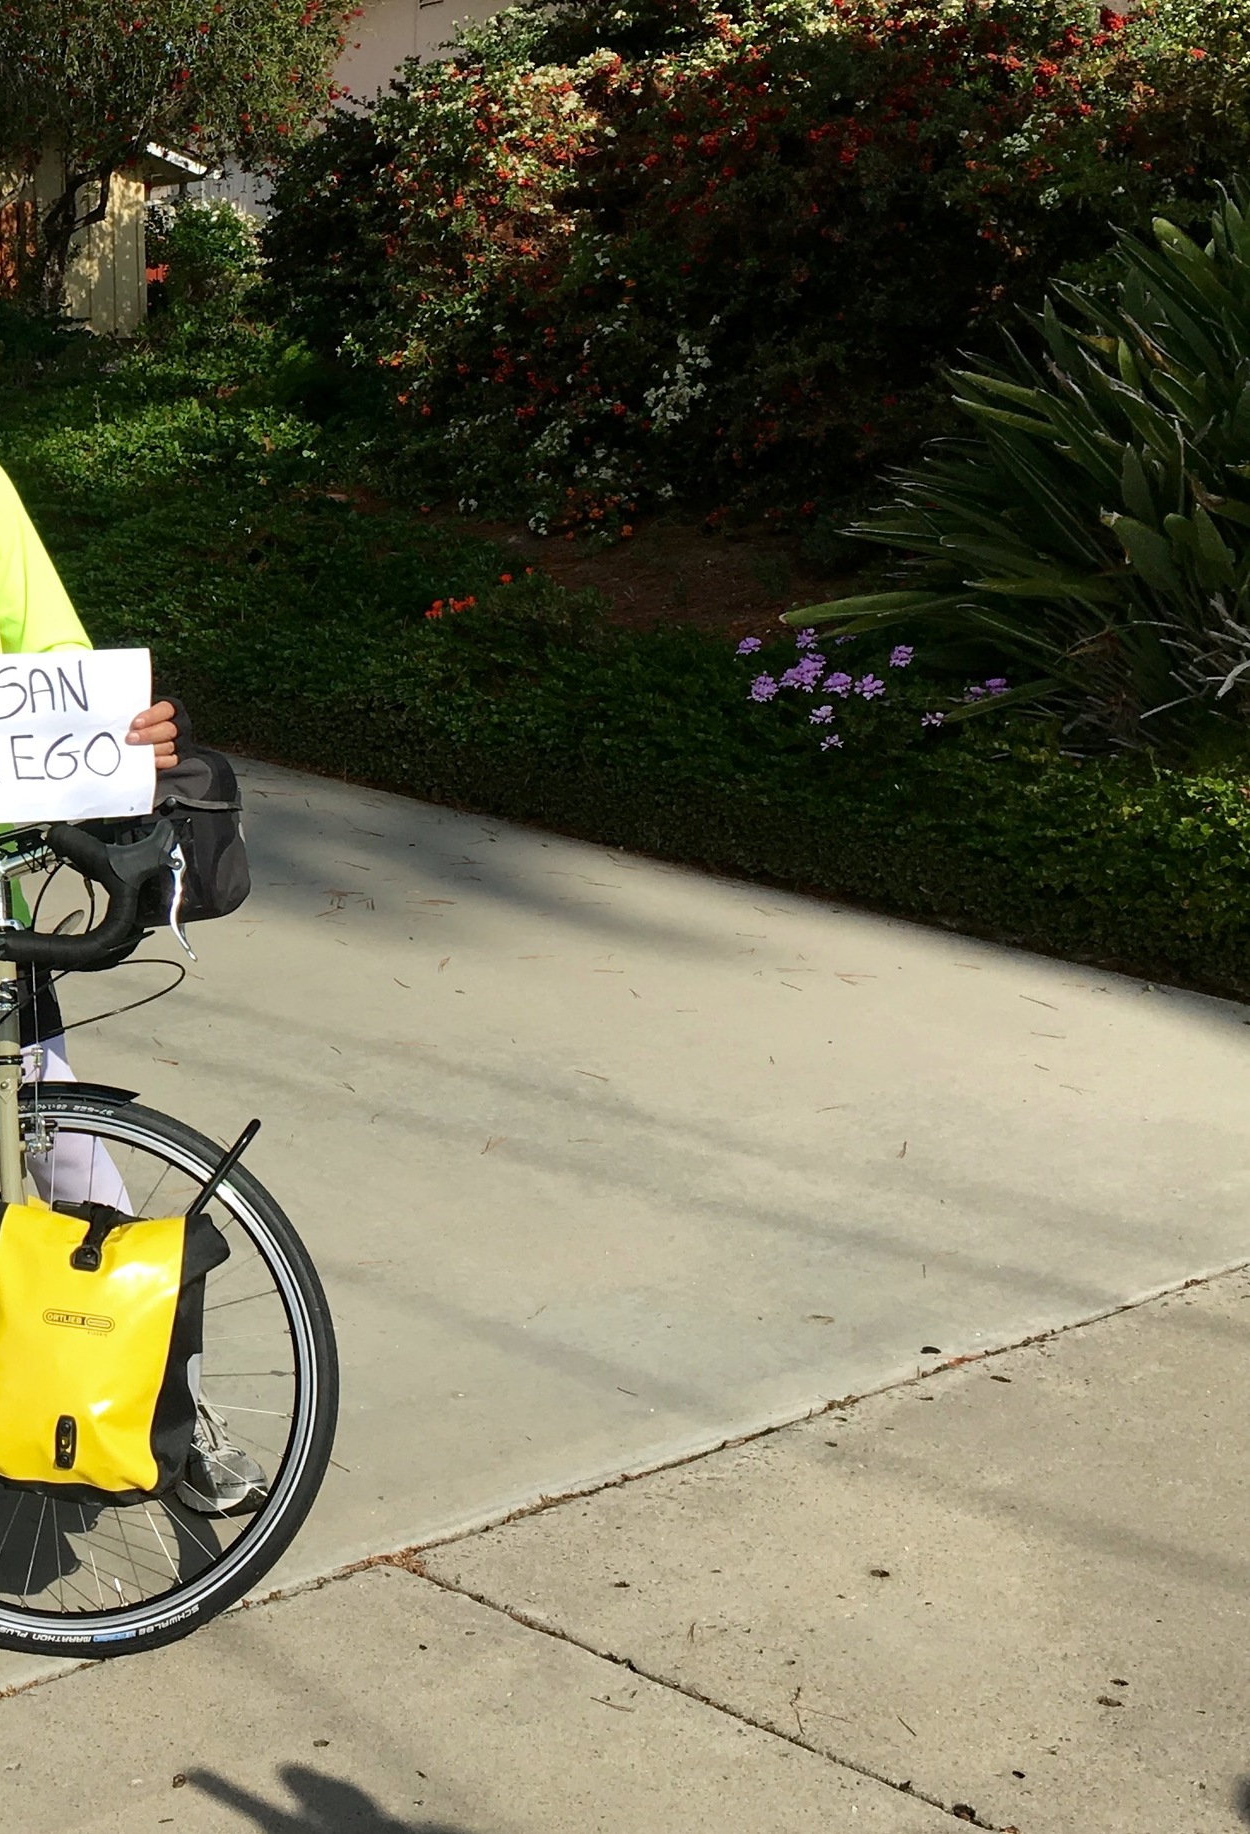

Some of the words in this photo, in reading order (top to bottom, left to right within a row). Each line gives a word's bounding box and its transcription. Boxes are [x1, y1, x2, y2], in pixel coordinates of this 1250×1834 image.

[47, 1312, 83, 1325] ORTLIEB
[138, 1603, 200, 1636] SCHWALBE
[0, 1627, 29, 1639] PLUS
[33, 1631, 92, 1643] MARATHON
